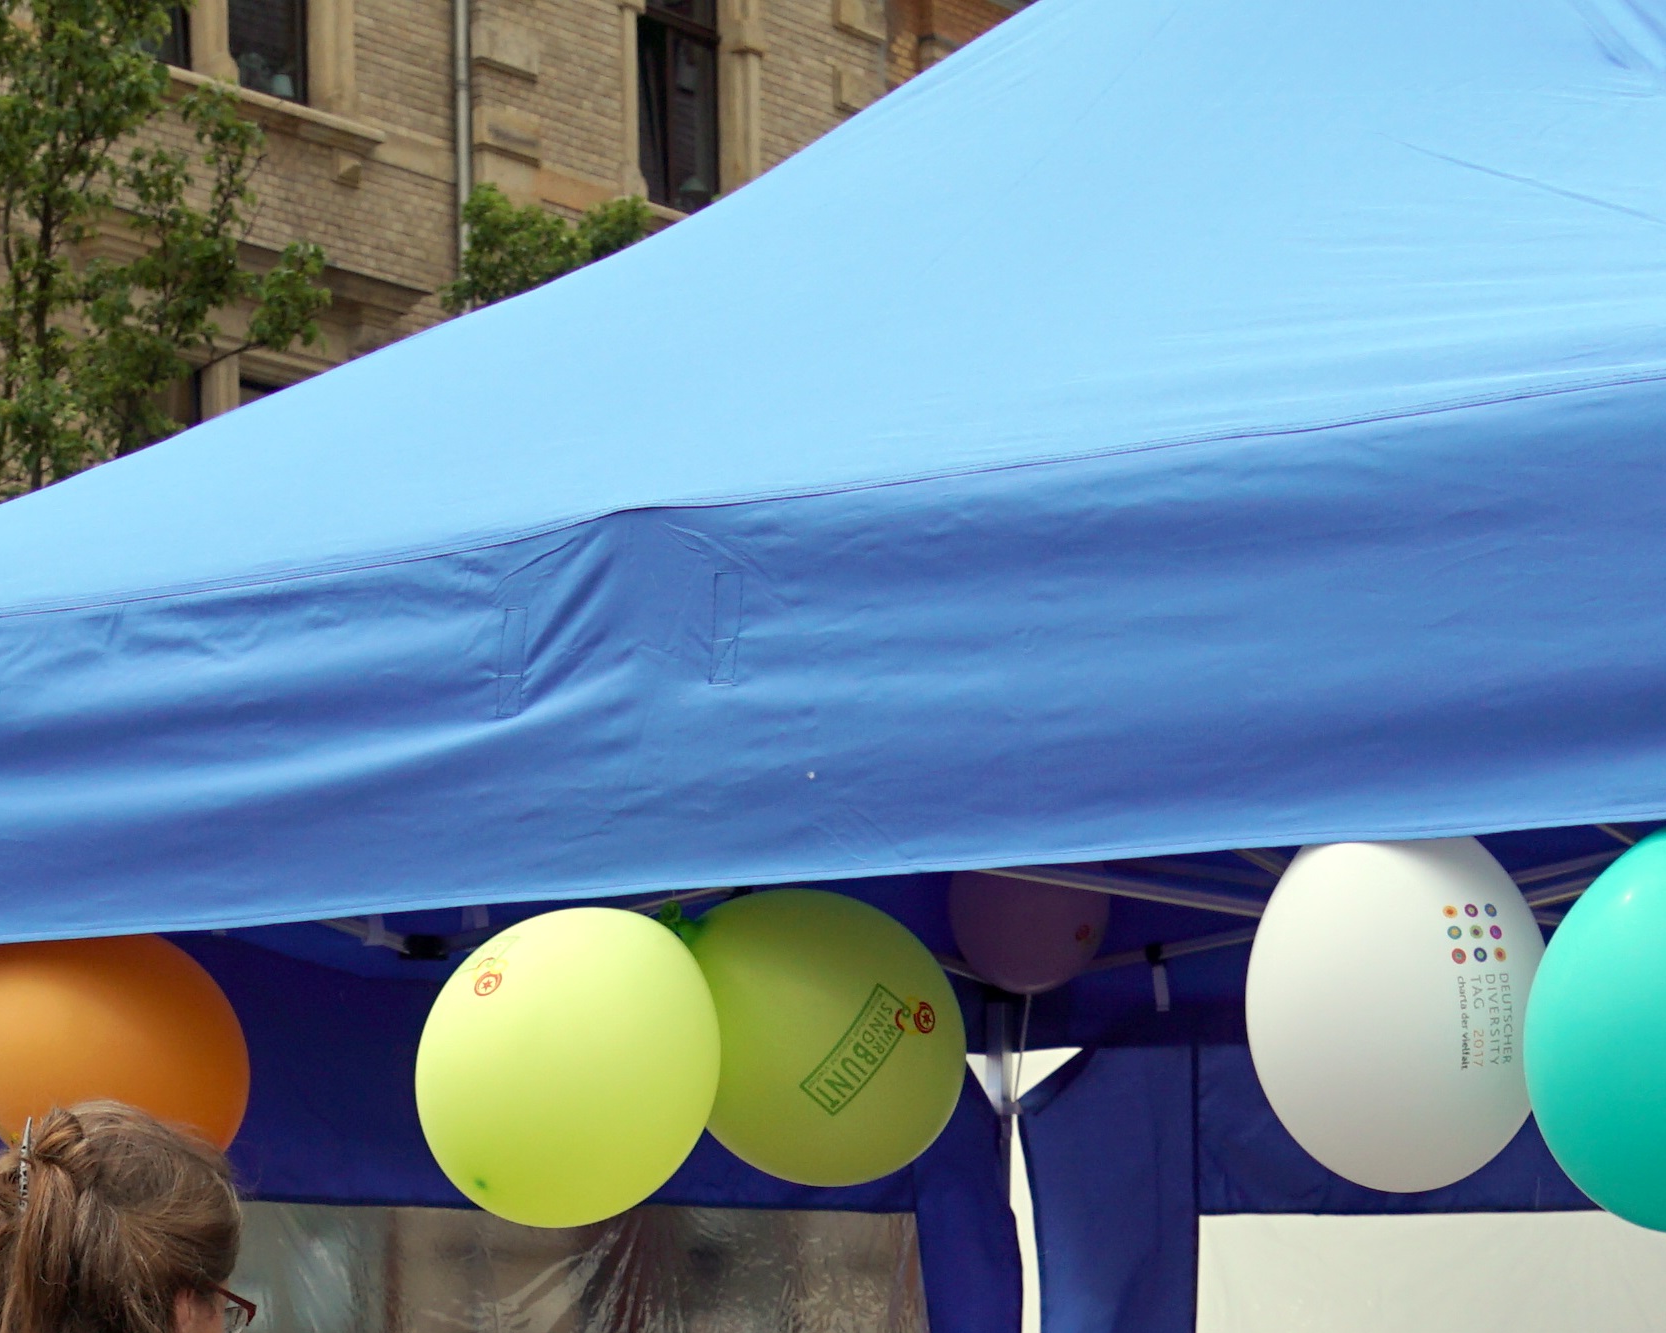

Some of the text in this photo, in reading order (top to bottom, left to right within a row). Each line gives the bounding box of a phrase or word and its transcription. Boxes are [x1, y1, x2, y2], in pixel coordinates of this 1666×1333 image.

[862, 1003, 892, 1043] SIND
[873, 1024, 897, 1054] WIR
[1470, 975, 1484, 1067] TAG 2017
[1485, 974, 1500, 1065] DIVERSITY
[1499, 973, 1513, 1064] DEUTSCHER
[817, 1042, 878, 1108] BUNT
